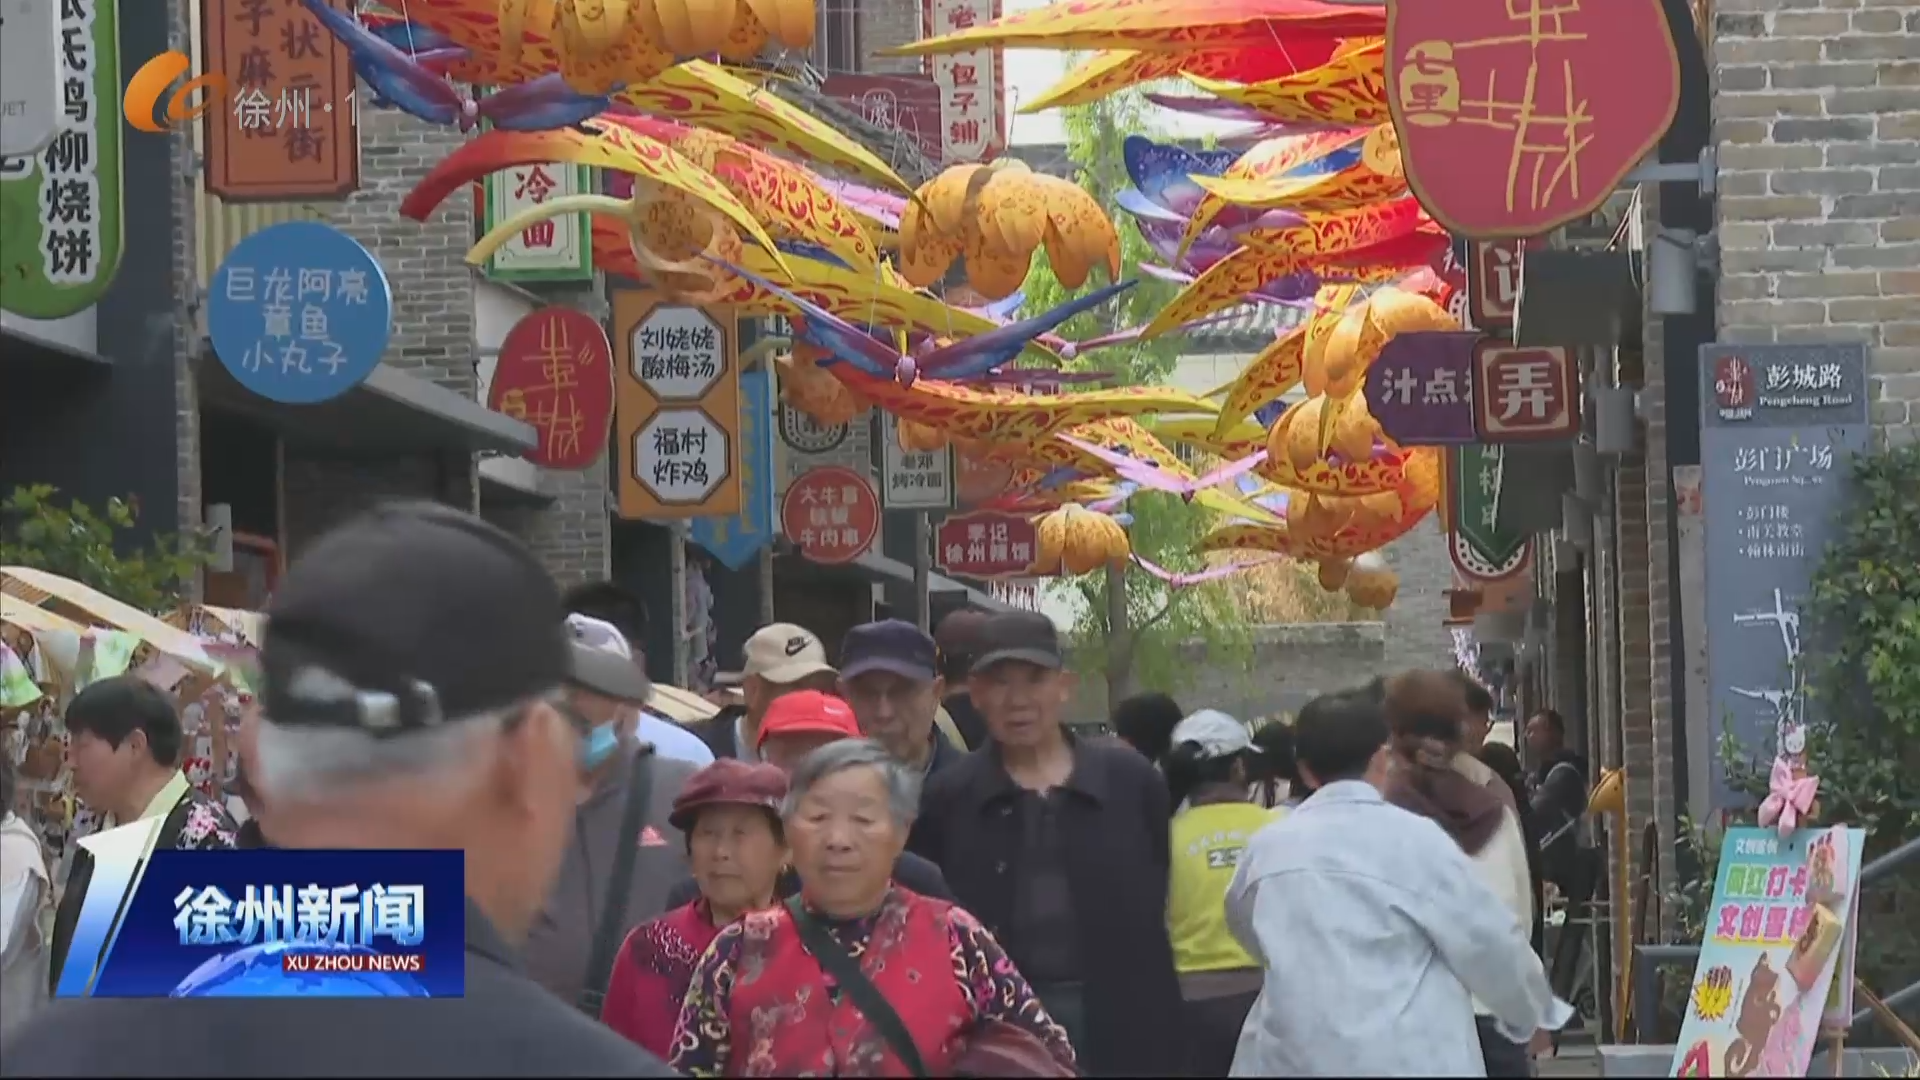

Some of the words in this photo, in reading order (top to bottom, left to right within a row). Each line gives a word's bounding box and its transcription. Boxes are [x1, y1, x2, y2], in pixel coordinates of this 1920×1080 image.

[226, 266, 369, 305] 巨龙阿亮
[262, 303, 329, 341] 章鱼
[640, 327, 716, 352] 刘姥姥
[241, 340, 348, 376] 小丸子
[640, 353, 717, 381] 酸梅汤
[1380, 367, 1473, 405] 汁点
[1765, 362, 1843, 391] 彭城路
[1759, 394, 1821, 408] Pengcheng
[1822, 393, 1853, 406] Road
[653, 427, 708, 455] 福村
[653, 458, 710, 488] 炸鸡
[1734, 445, 1833, 473] 彭门广场
